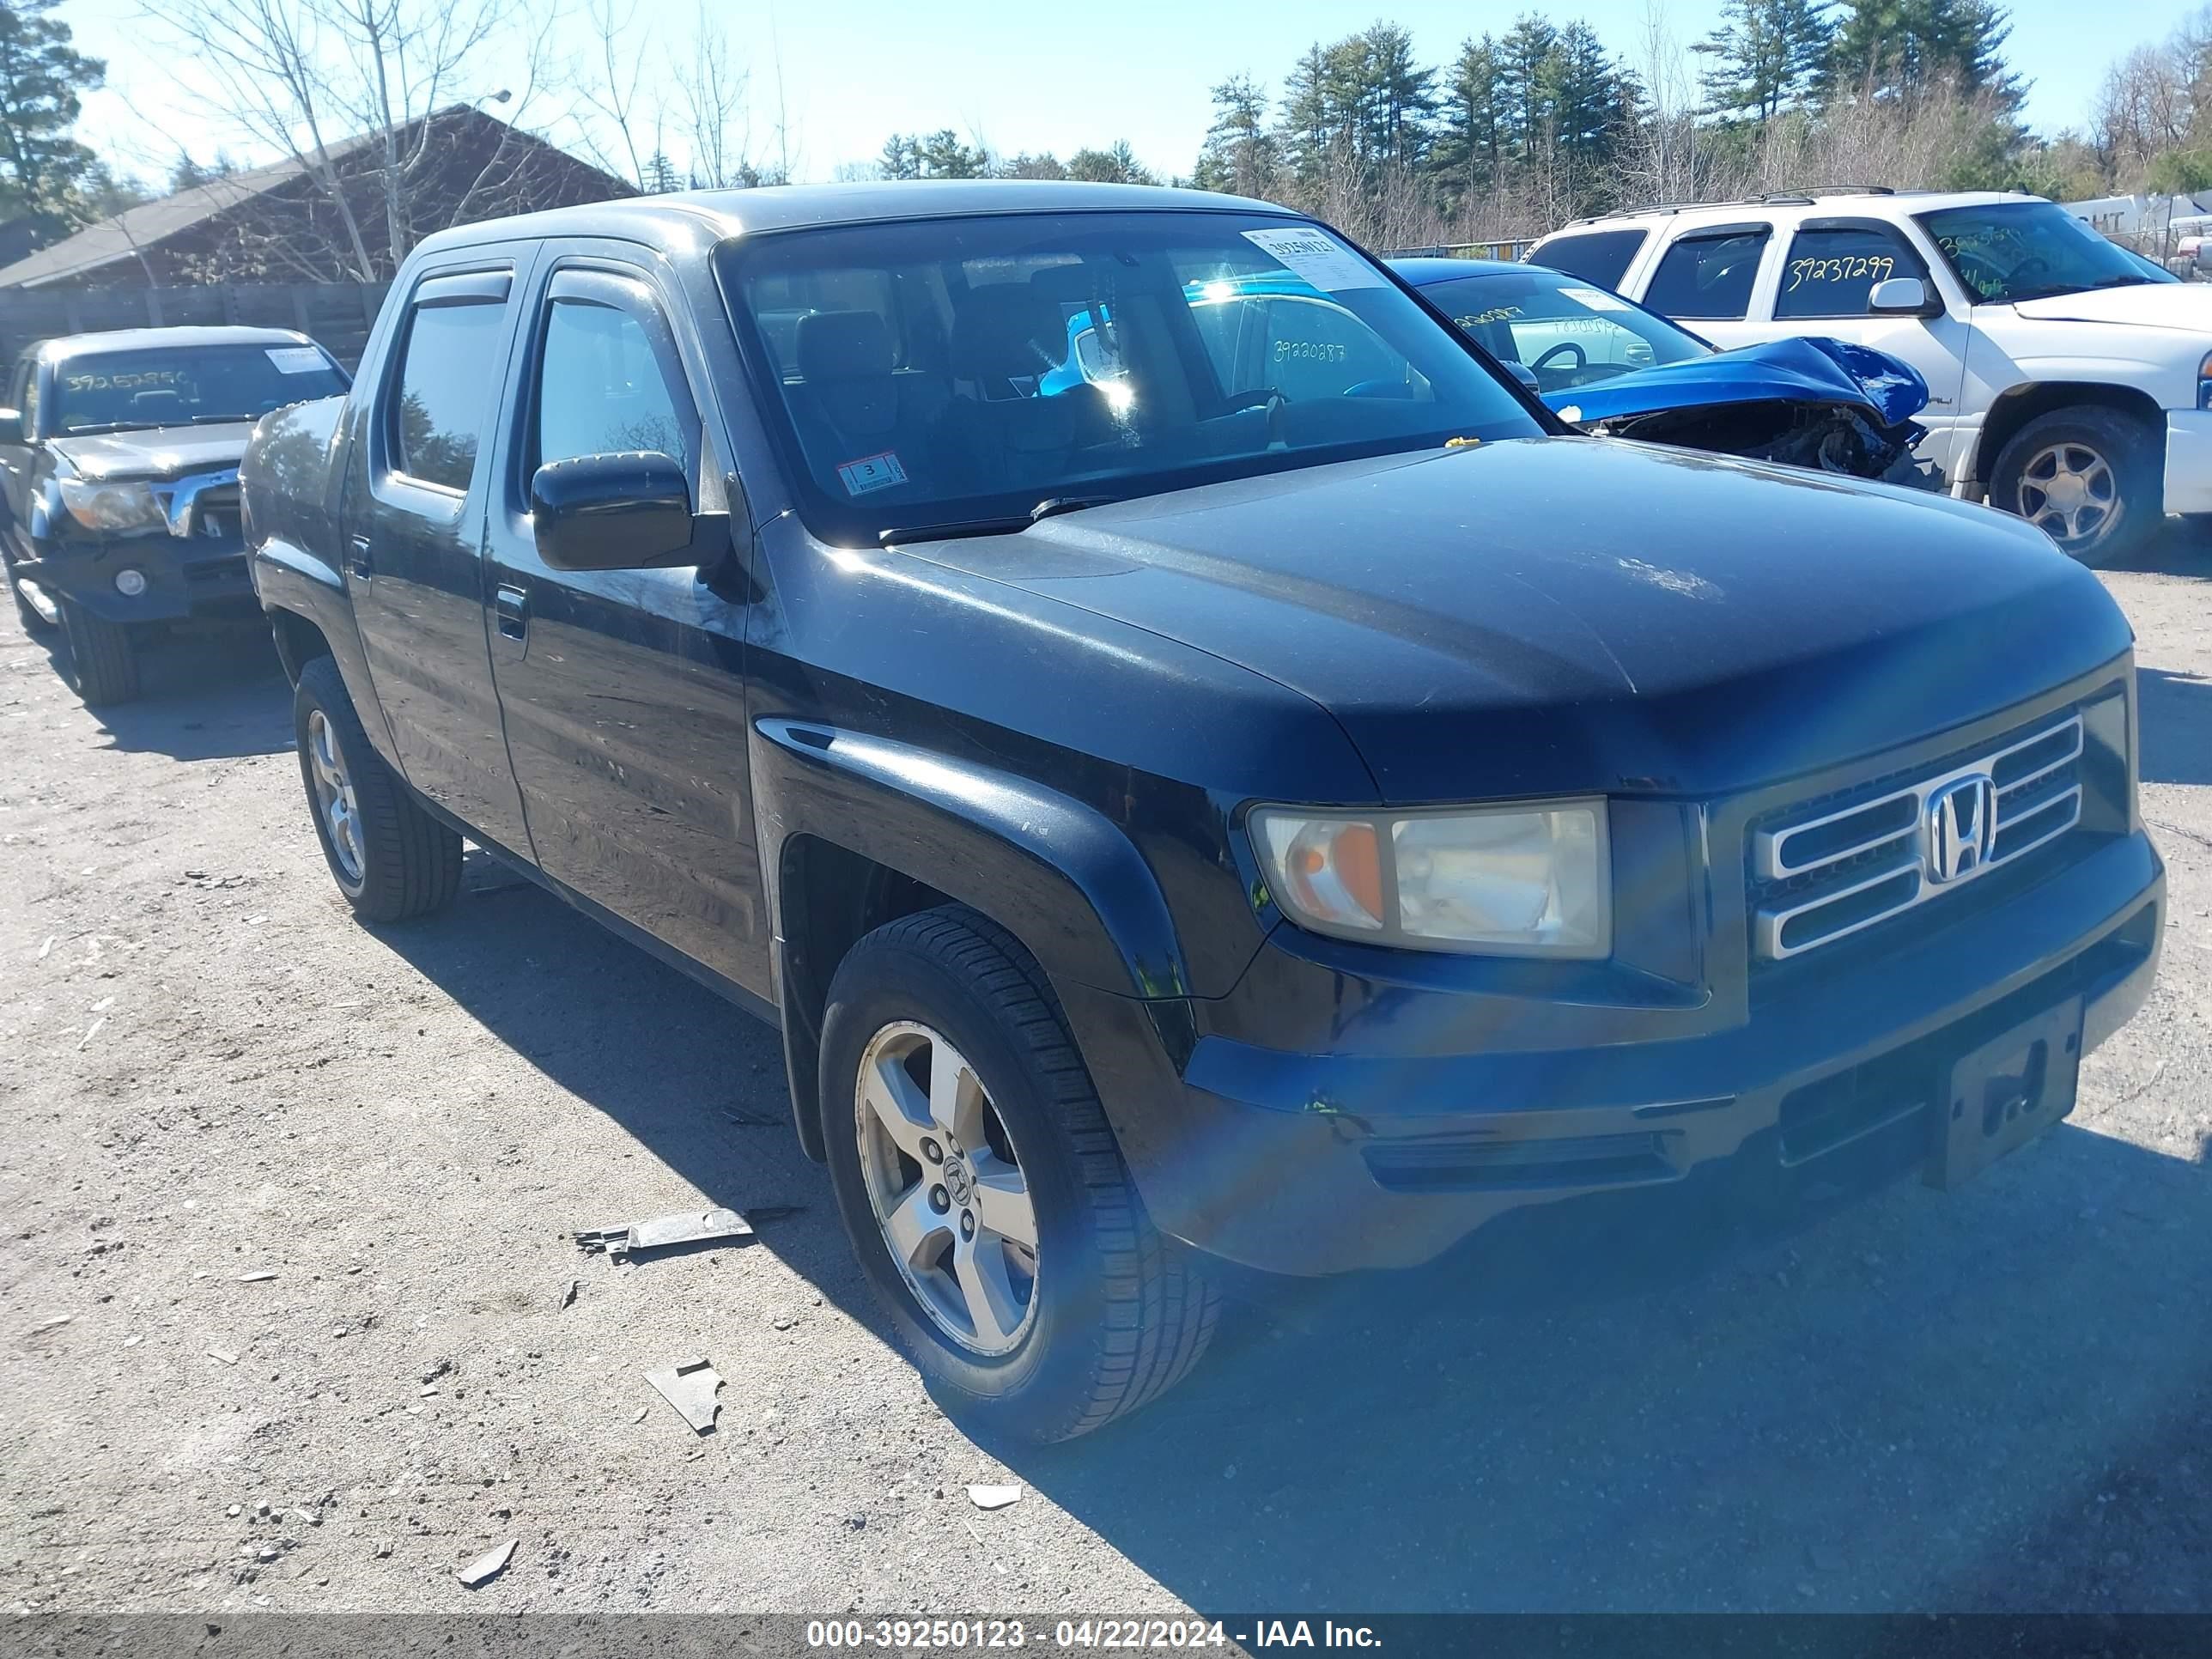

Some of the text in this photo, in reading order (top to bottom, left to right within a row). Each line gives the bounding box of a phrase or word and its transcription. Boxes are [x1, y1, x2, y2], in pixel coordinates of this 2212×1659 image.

[1268, 240, 1336, 255] 39250123
[1787, 256, 1894, 292] 39237299
[1273, 340, 1346, 362] 39220287
[864, 465, 875, 476] 3
